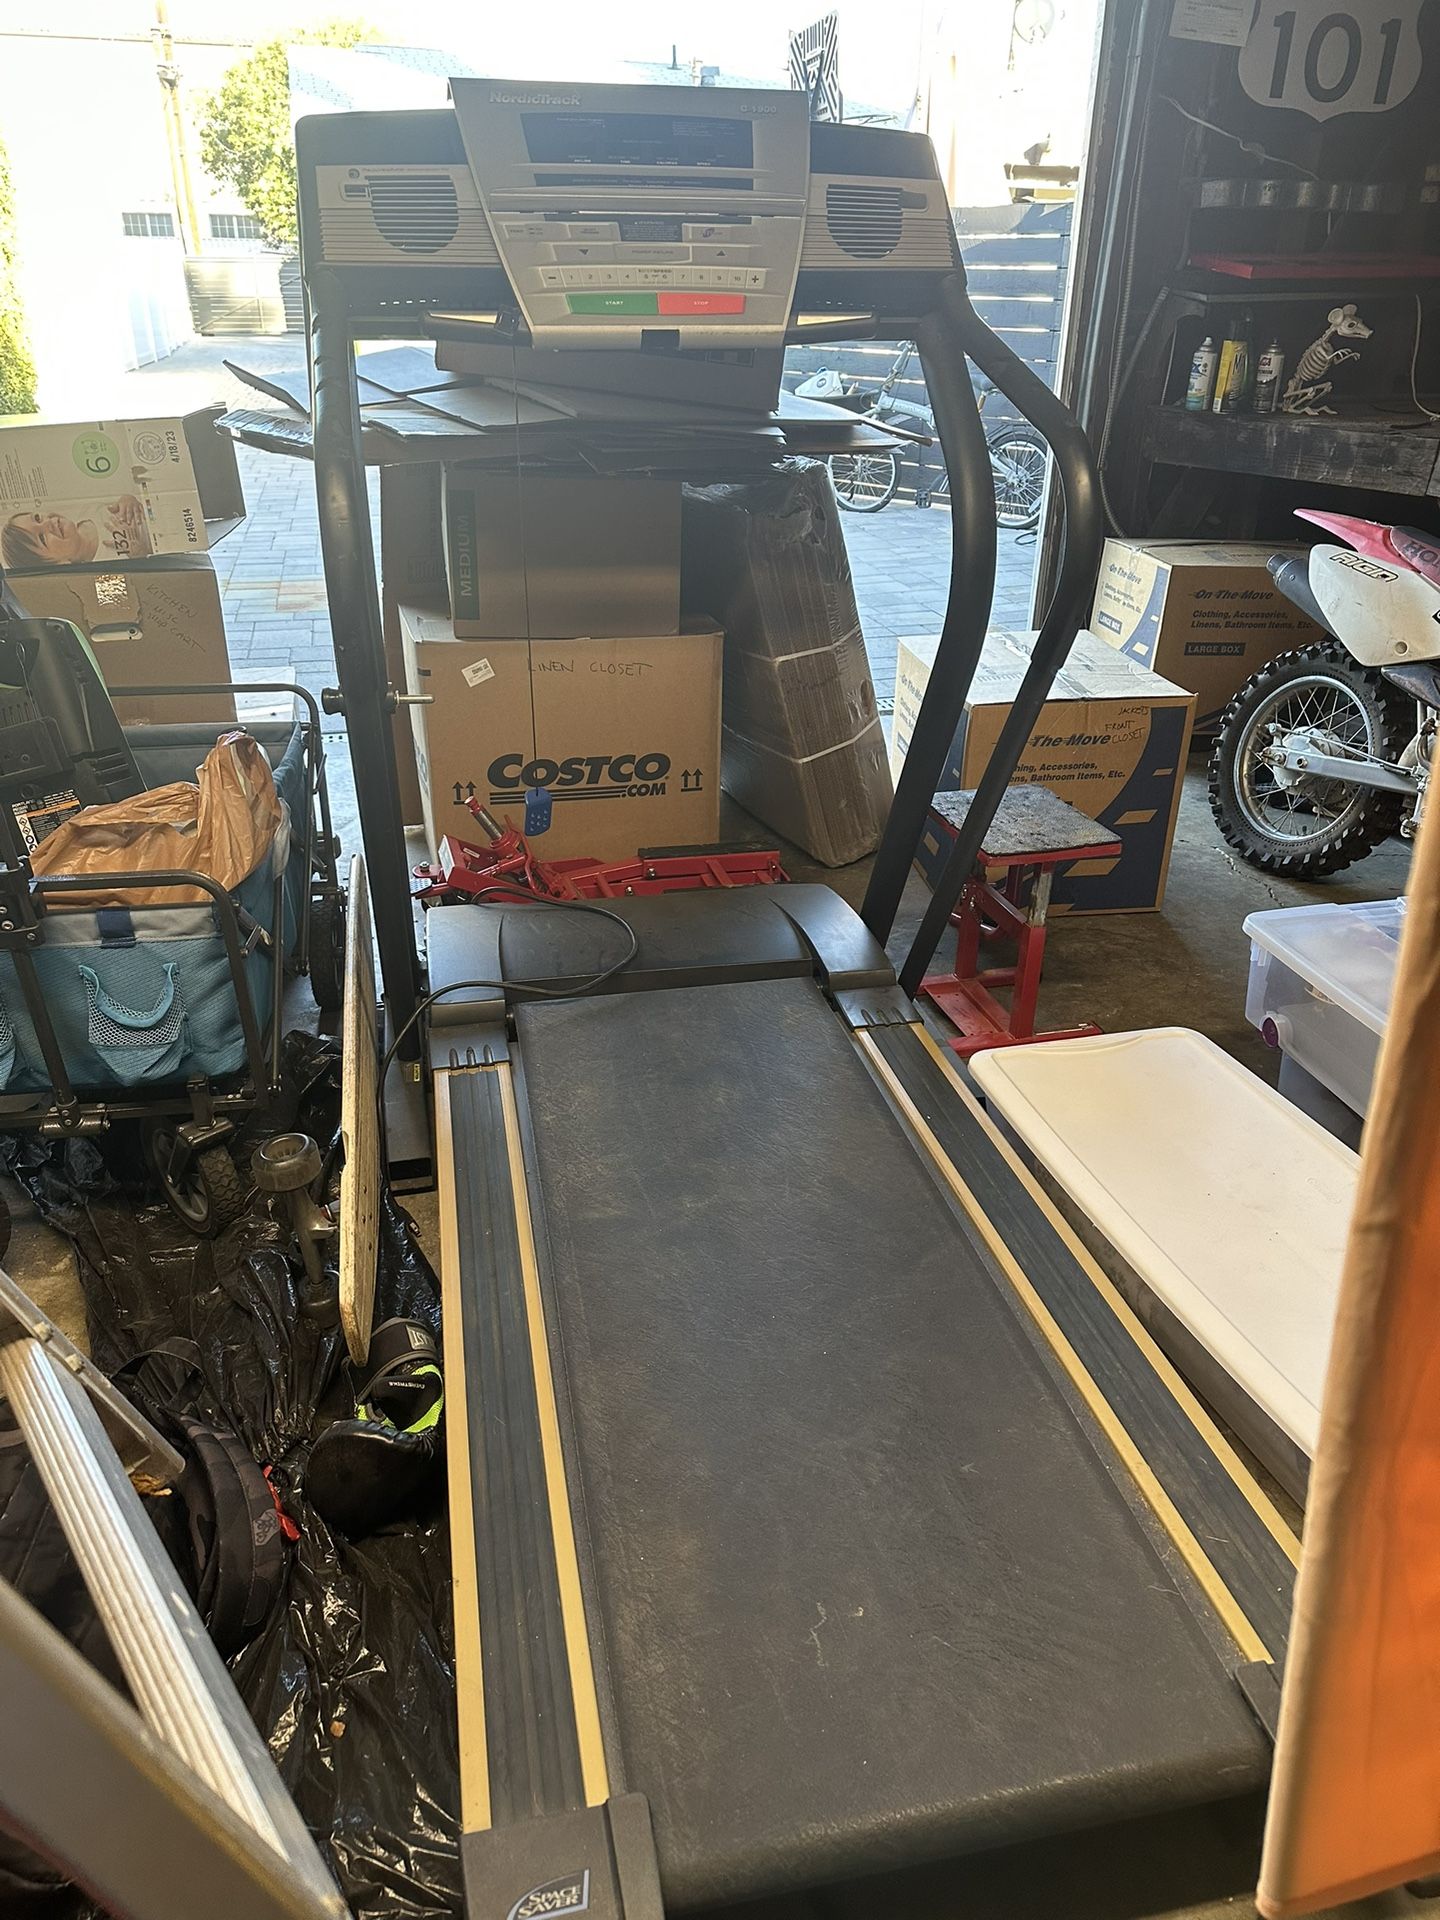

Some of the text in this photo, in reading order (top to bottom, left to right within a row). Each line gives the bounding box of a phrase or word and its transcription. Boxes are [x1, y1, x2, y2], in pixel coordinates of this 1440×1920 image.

[1269, 10, 1402, 105] 101
[489, 91, 580, 105] NordicTrack
[166, 430, 181, 463] 4/18/23
[86, 456, 111, 474] 6
[182, 507, 198, 543] 8246514
[112, 529, 131, 557] 132
[457, 514, 473, 597] MEDIUM
[1195, 589, 1274, 600] On The Move
[1192, 609, 1288, 620] Clothing, Accessories,
[1190, 621, 1313, 630] Linens, Bathroom Items, Etc.
[1187, 645, 1240, 654] LARGE BOX
[589, 661, 653, 676] CLOSET
[1104, 720, 1135, 732] FRONT
[1030, 733, 1112, 748] The Move
[1111, 727, 1147, 744] CLOSET
[487, 752, 671, 789] COSTCO
[1039, 761, 1098, 772] Accessories,
[1030, 773, 1075, 783] Bathroom
[1077, 771, 1105, 781] Items,
[1108, 770, 1126, 778] Etc.
[528, 1884, 581, 1907] SPACE
[517, 1894, 579, 1919] SAVER
